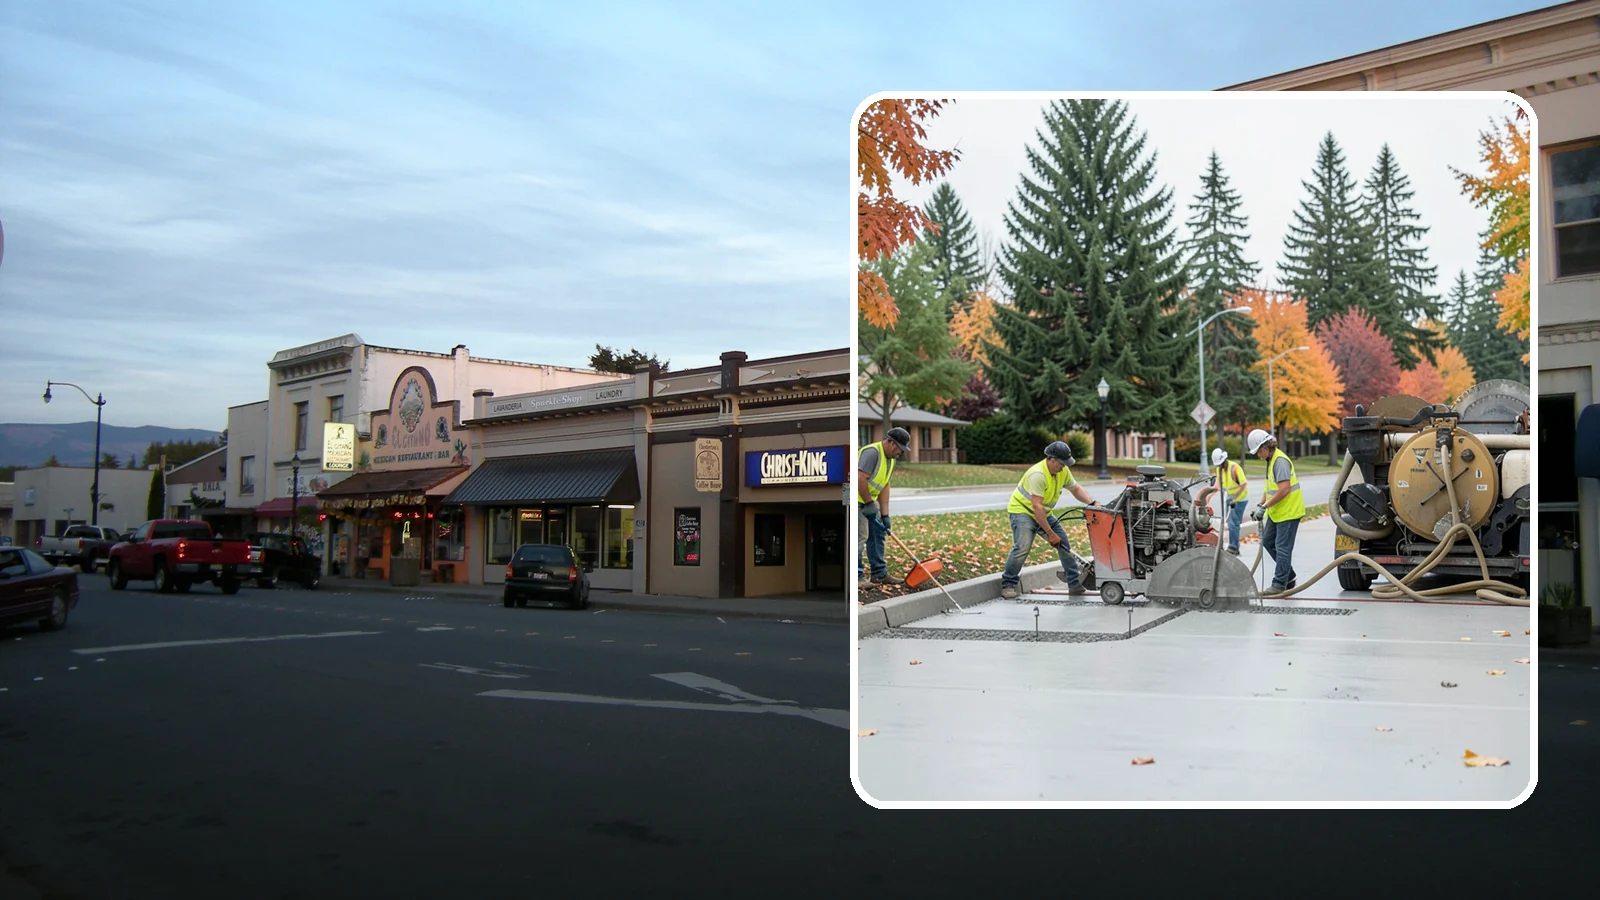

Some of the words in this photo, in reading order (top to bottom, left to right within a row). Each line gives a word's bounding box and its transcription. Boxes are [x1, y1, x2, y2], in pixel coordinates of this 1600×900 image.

[595, 389, 623, 400] LAUNDRY
[493, 402, 522, 412] LAVANDERIA
[530, 397, 561, 409] Sparkle
[562, 394, 583, 405] Shop
[373, 454, 396, 464] MEXICAN
[397, 451, 433, 462] RESTAURANT
[437, 450, 449, 459] BAR
[760, 452, 797, 478] CHRIST
[799, 450, 827, 476] KING
[696, 480, 709, 488] Coffee
